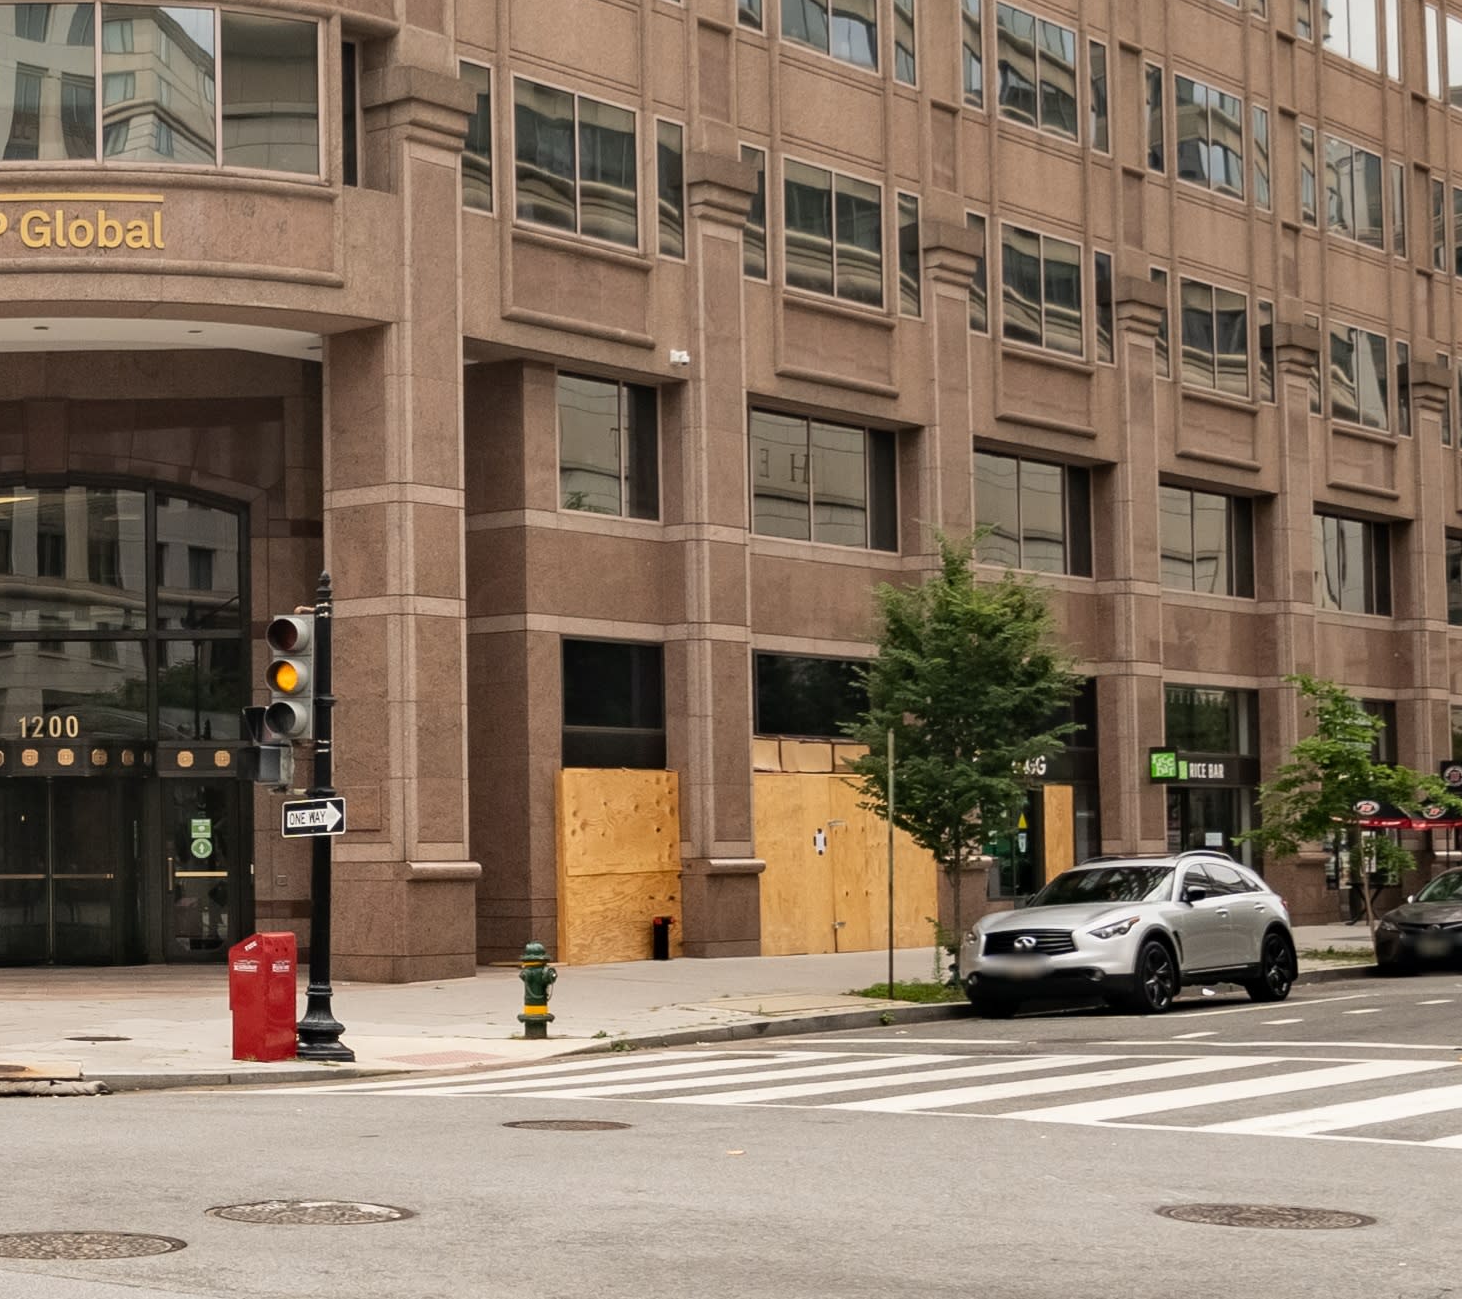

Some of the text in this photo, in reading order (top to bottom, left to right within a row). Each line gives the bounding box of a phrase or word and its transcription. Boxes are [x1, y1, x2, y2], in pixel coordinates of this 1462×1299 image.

[20, 209, 165, 250] Global
[18, 715, 79, 738] 1200
[1189, 763, 1225, 778] RICE BAR
[289, 810, 326, 826] ONE WAY
